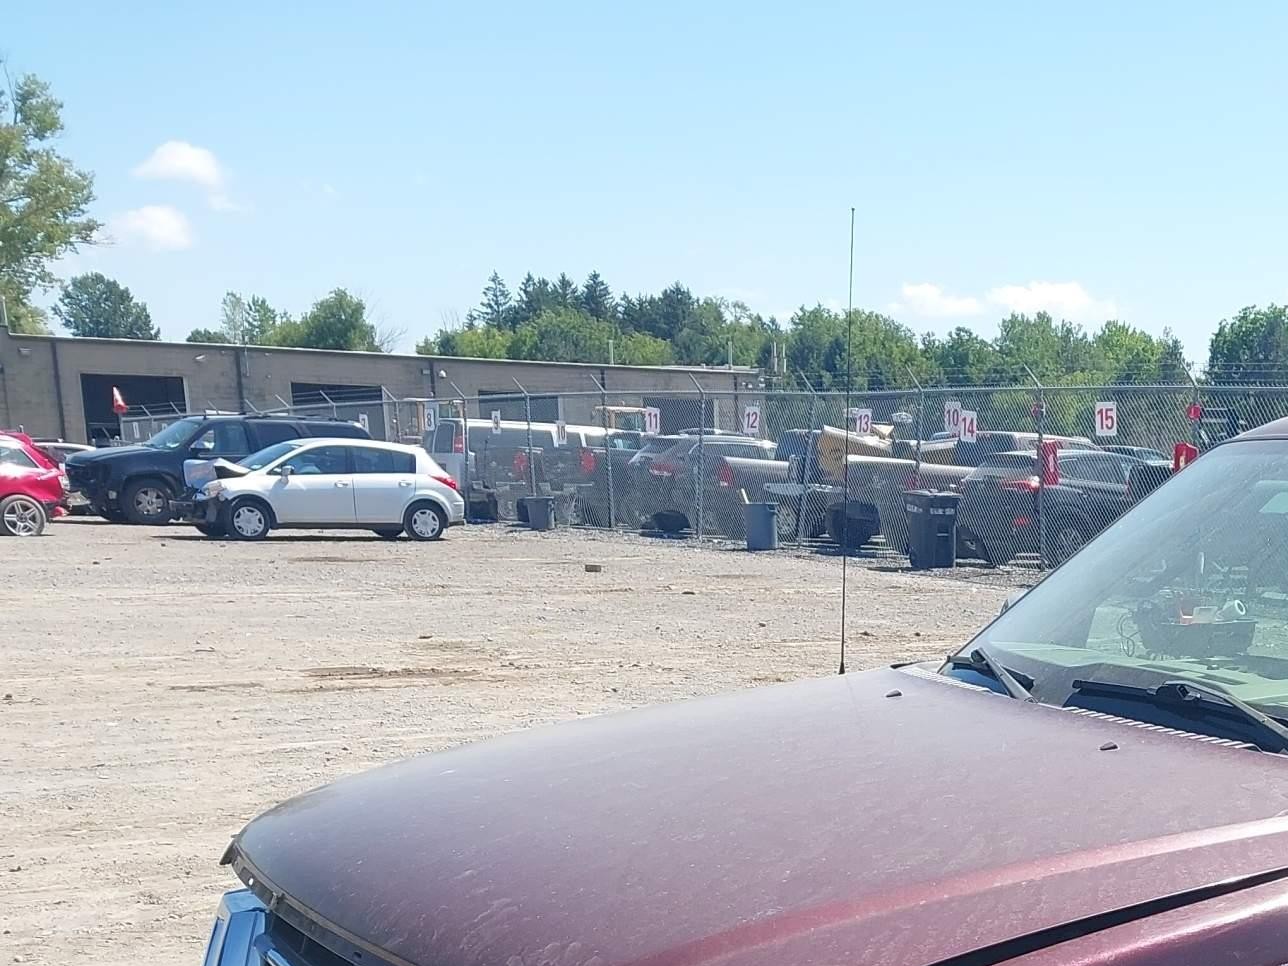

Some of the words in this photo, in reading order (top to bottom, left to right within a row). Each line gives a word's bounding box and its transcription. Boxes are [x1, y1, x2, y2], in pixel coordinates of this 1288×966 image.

[425, 412, 433, 428] 8
[647, 411, 659, 430] 11
[745, 410, 759, 429] 12
[857, 413, 870, 433] 13
[945, 408, 960, 427] 10
[960, 416, 976, 437] 14
[1096, 407, 1115, 431] 15
